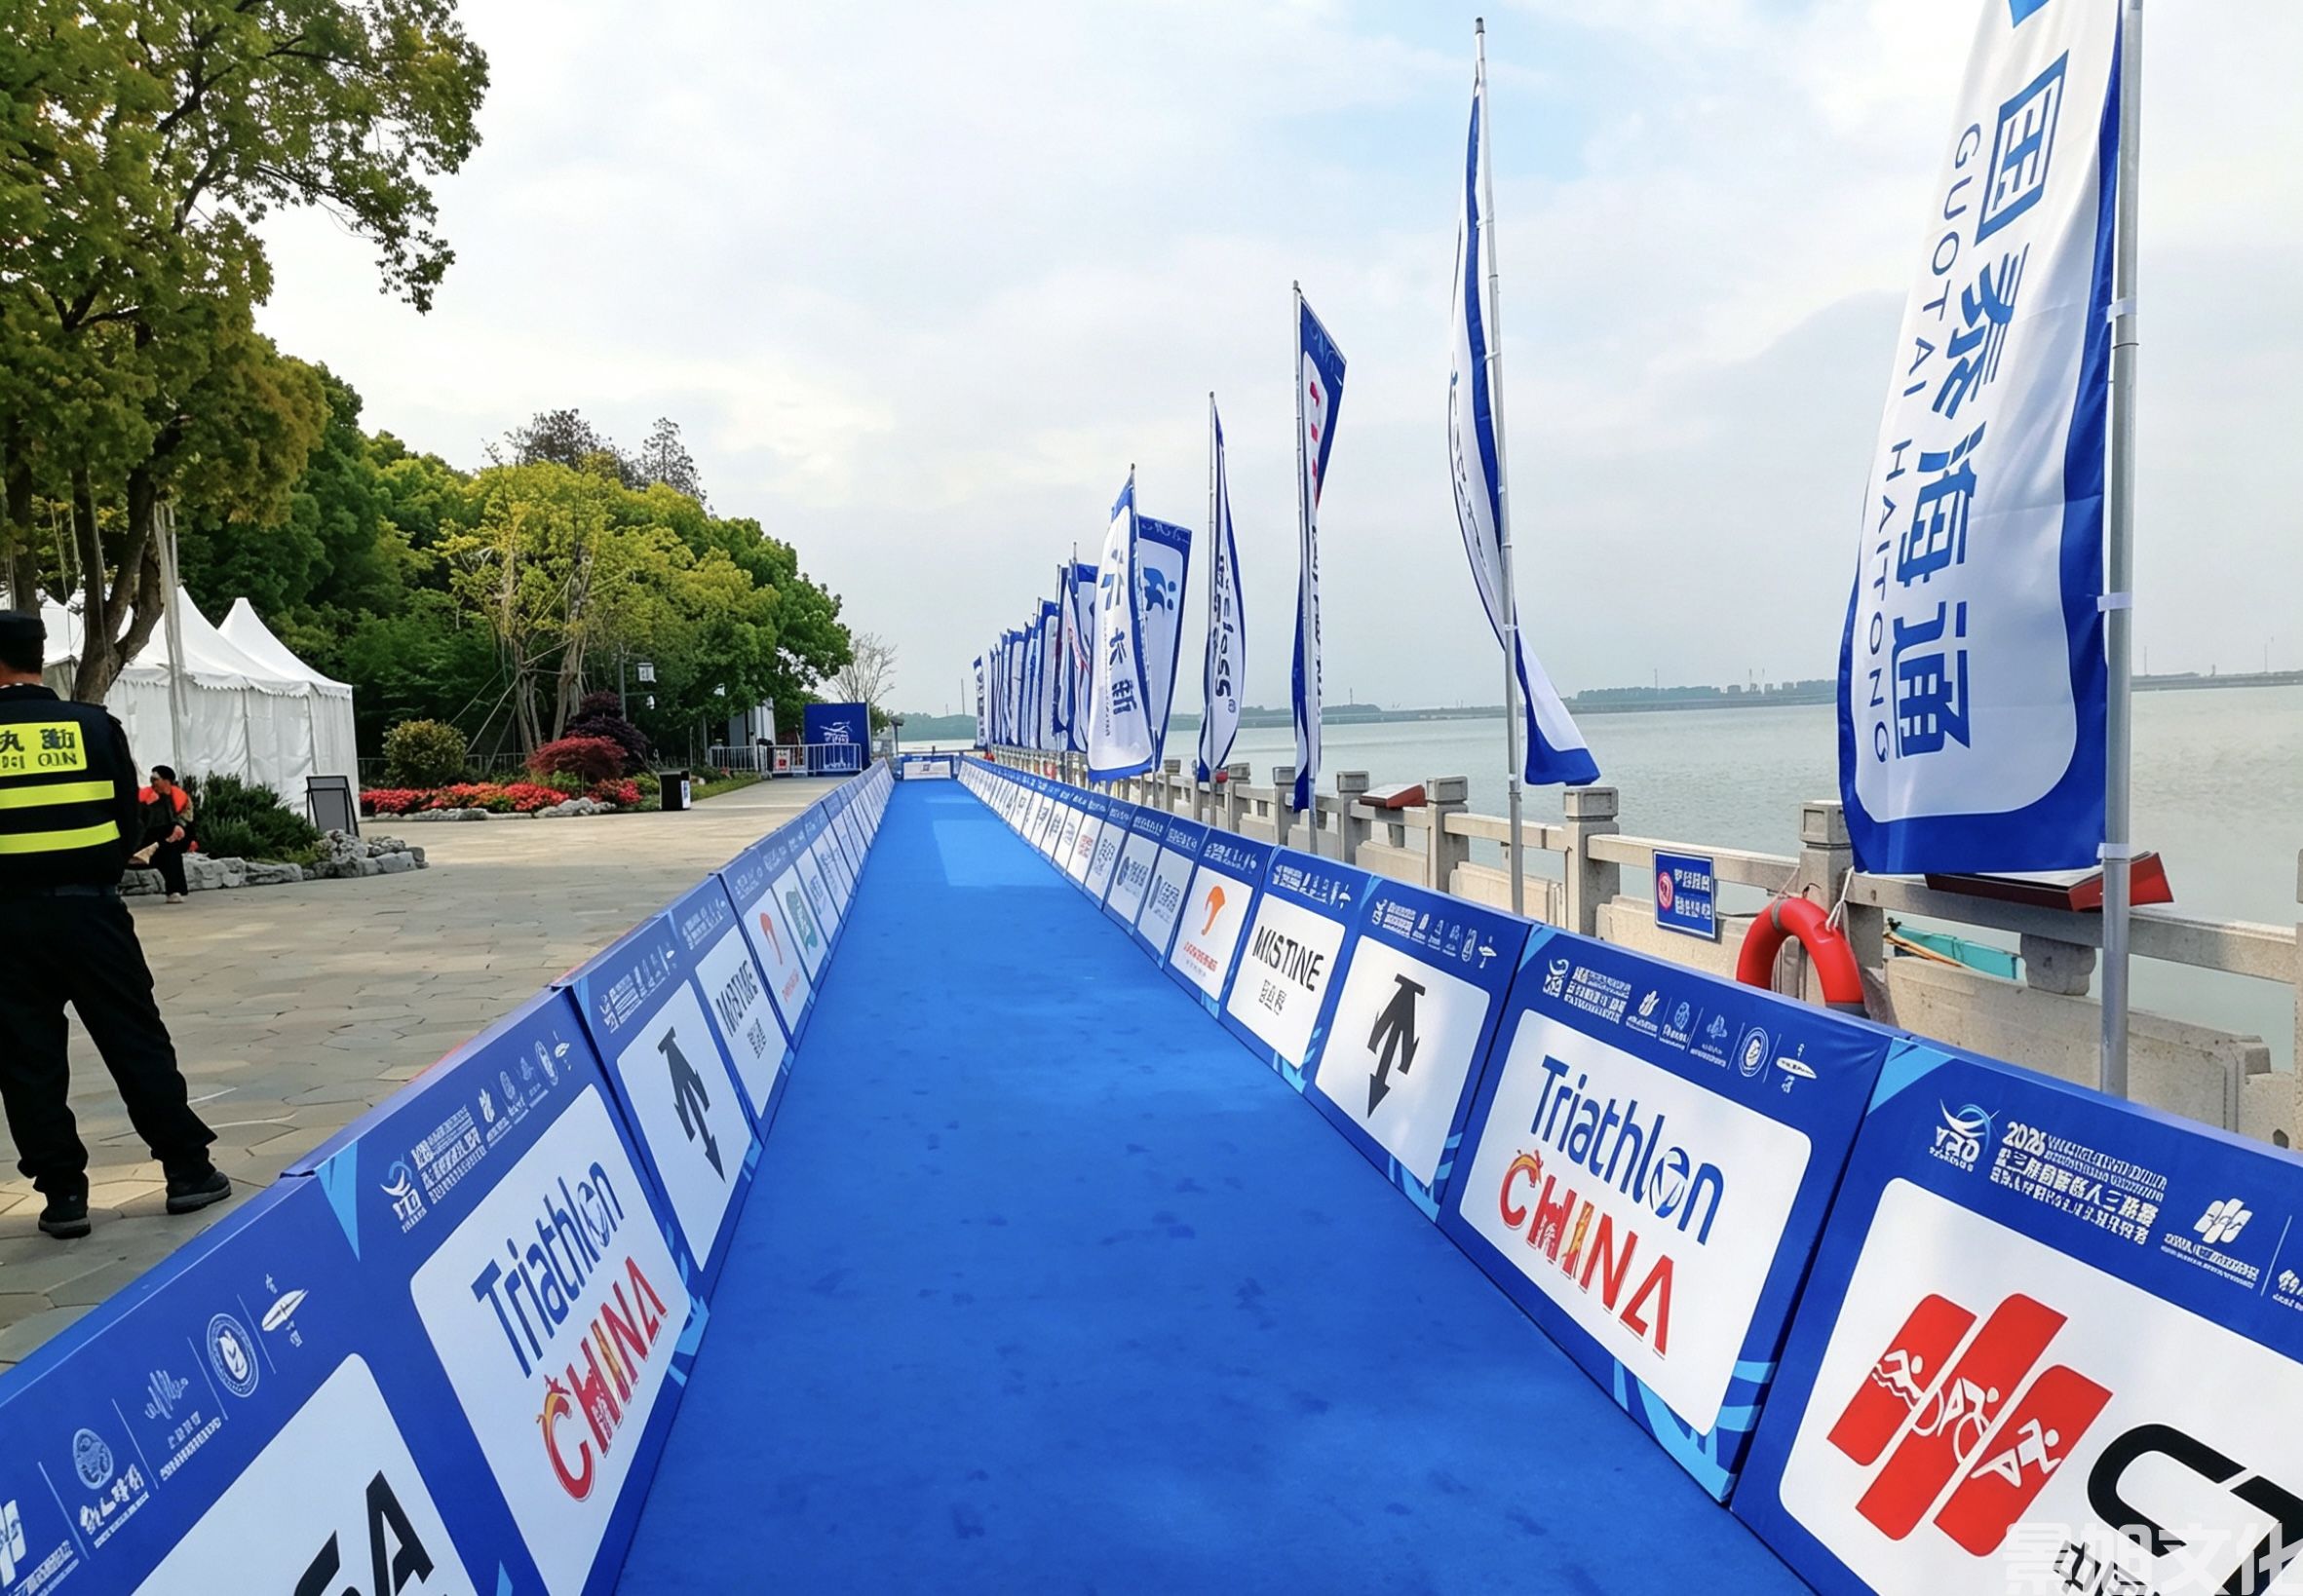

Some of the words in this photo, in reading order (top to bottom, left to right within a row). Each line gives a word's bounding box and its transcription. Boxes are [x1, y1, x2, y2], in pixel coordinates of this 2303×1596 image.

[1903, 123, 1980, 398] GUOTAI
[1894, 50, 2070, 760] 国泰海通
[1867, 439, 1913, 763] HAITONG
[1251, 925, 1325, 993] MISTINE
[1499, 1149, 1678, 1360] CHINA
[1528, 1054, 1725, 1246] Triathlon
[470, 1160, 625, 1380] Triathlon
[536, 1255, 669, 1502] CHINA
